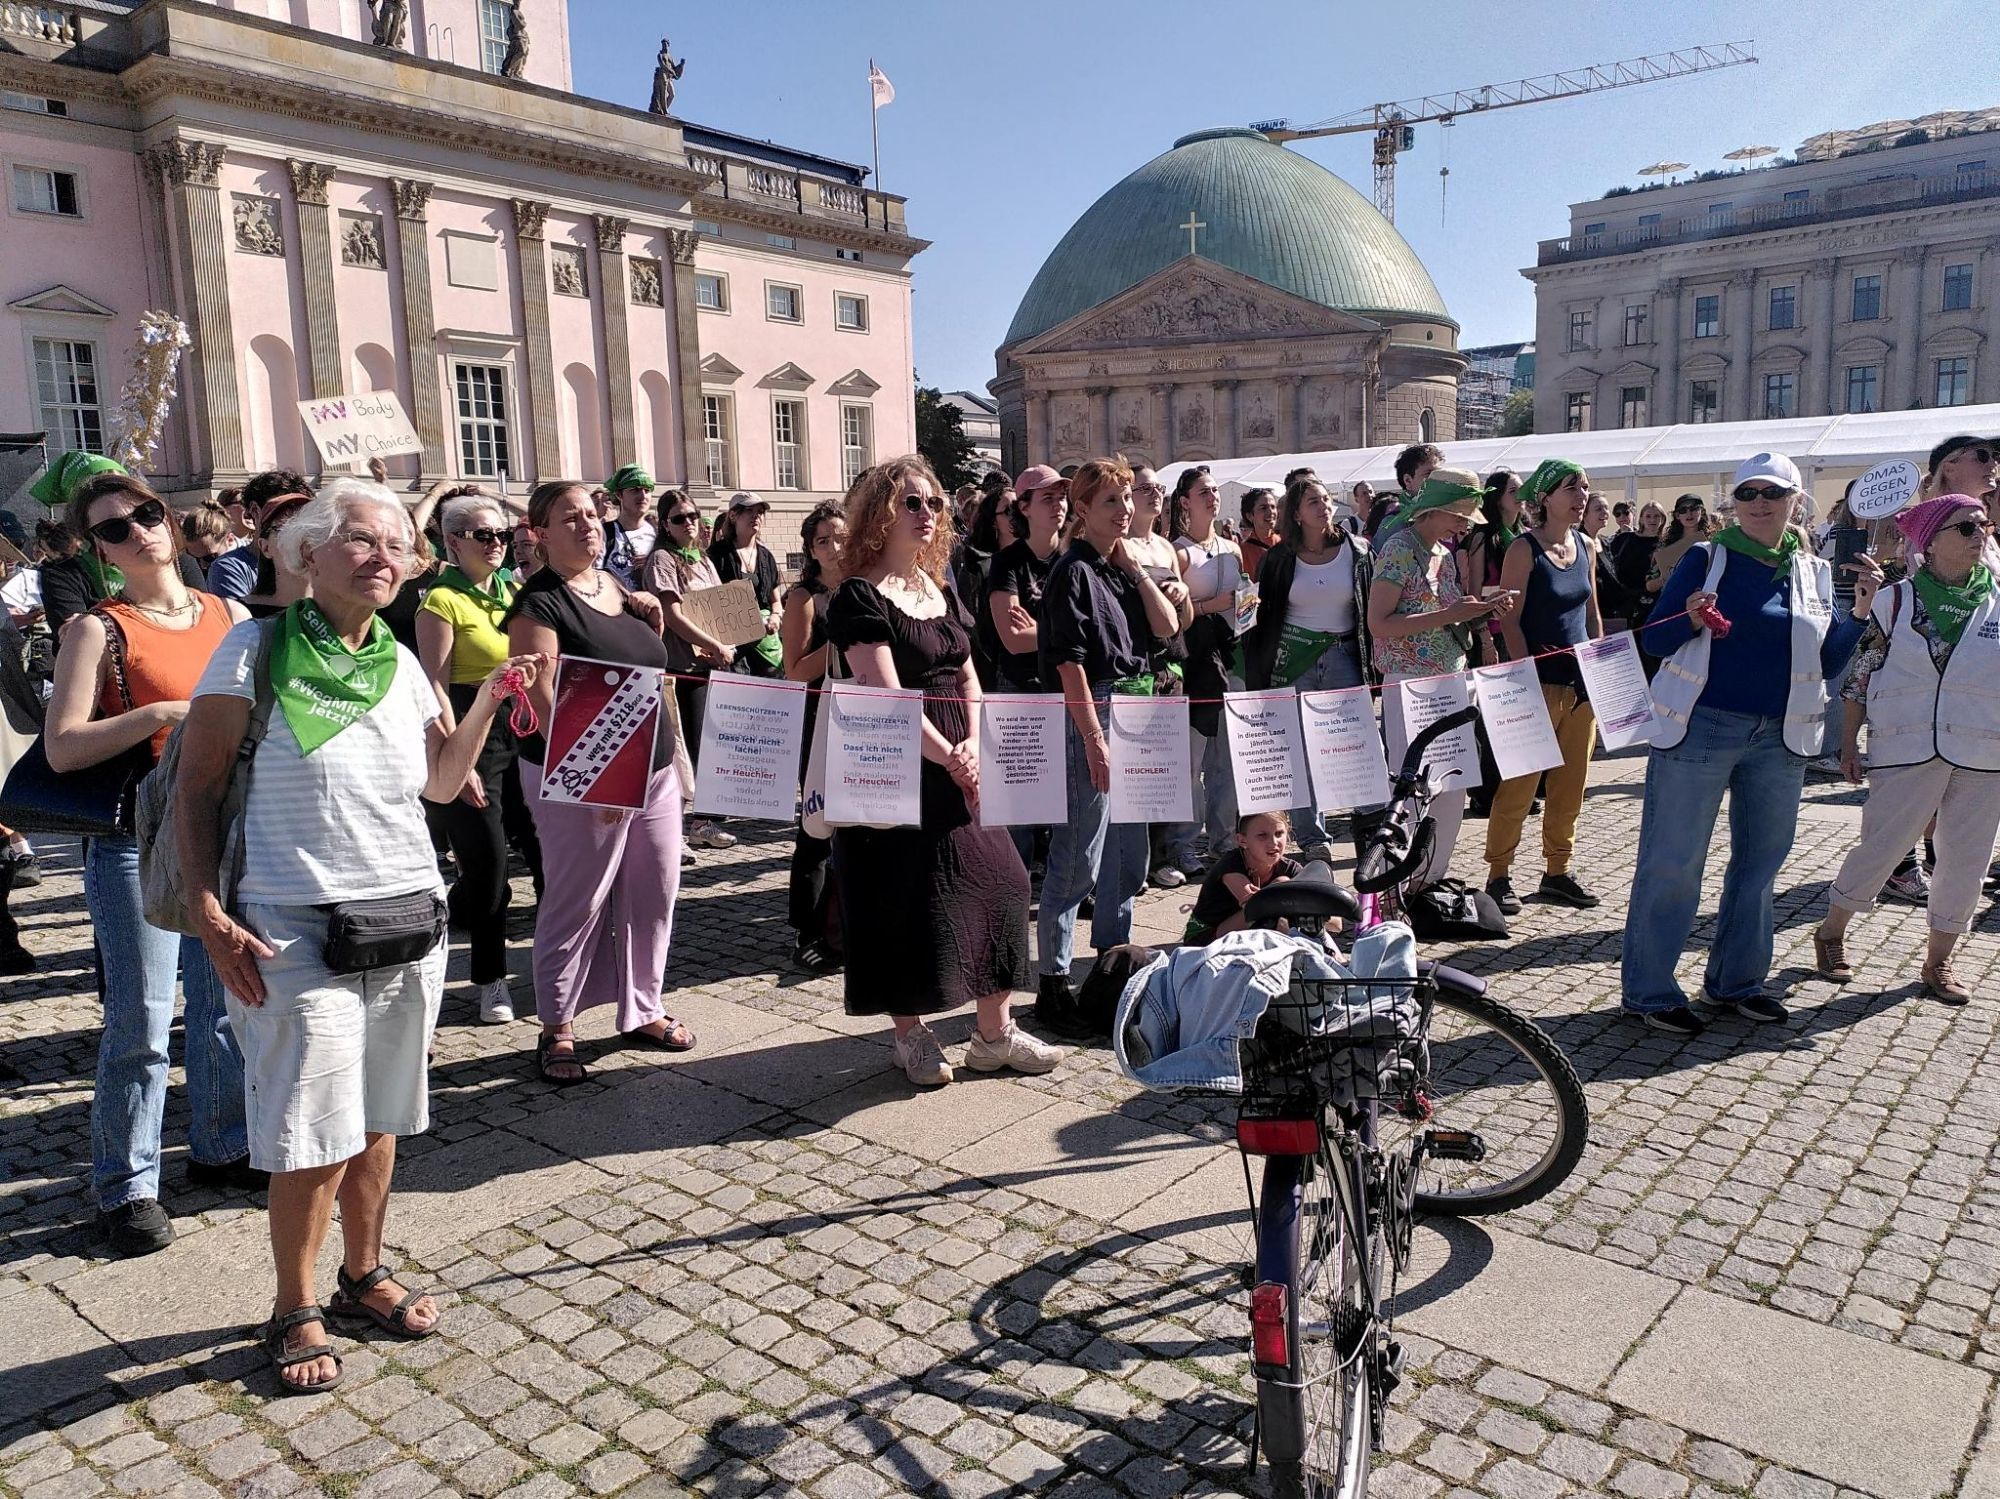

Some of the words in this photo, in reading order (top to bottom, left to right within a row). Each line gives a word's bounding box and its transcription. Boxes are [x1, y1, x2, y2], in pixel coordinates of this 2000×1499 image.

[1863, 234, 1879, 245] DE
[311, 400, 347, 424] MY
[352, 396, 395, 419] Body
[325, 432, 359, 458] MY
[365, 434, 413, 452] Choice
[1864, 462, 1906, 483] OMAS
[1860, 475, 1907, 498] GEGEN
[1857, 488, 1910, 512] RECHTS
[306, 703, 352, 728] Jetzt!
[1342, 716, 1360, 724] nicht
[586, 742, 605, 762] weg
[601, 727, 616, 745] mit
[610, 702, 635, 729] §218
[1269, 728, 1286, 736] Land
[1328, 726, 1348, 734] lache!
[718, 734, 740, 742] Dass
[758, 736, 781, 747] nicht
[1250, 740, 1274, 748] jährlich
[735, 744, 762, 755] lache!
[844, 744, 863, 752] Dass
[882, 745, 903, 754] nicht
[1268, 746, 1290, 754] Kinder
[1332, 743, 1366, 754] Heuchler!
[860, 753, 886, 763] lache!
[1246, 755, 1285, 764] misshandelt
[733, 768, 776, 780] Heuchler!
[1250, 764, 1284, 774] werden???
[860, 777, 901, 786] Heuchler!
[1244, 776, 1262, 785] (auch
[1272, 782, 1288, 790] hohe
[1250, 792, 1292, 801] Dunkelziffer)
